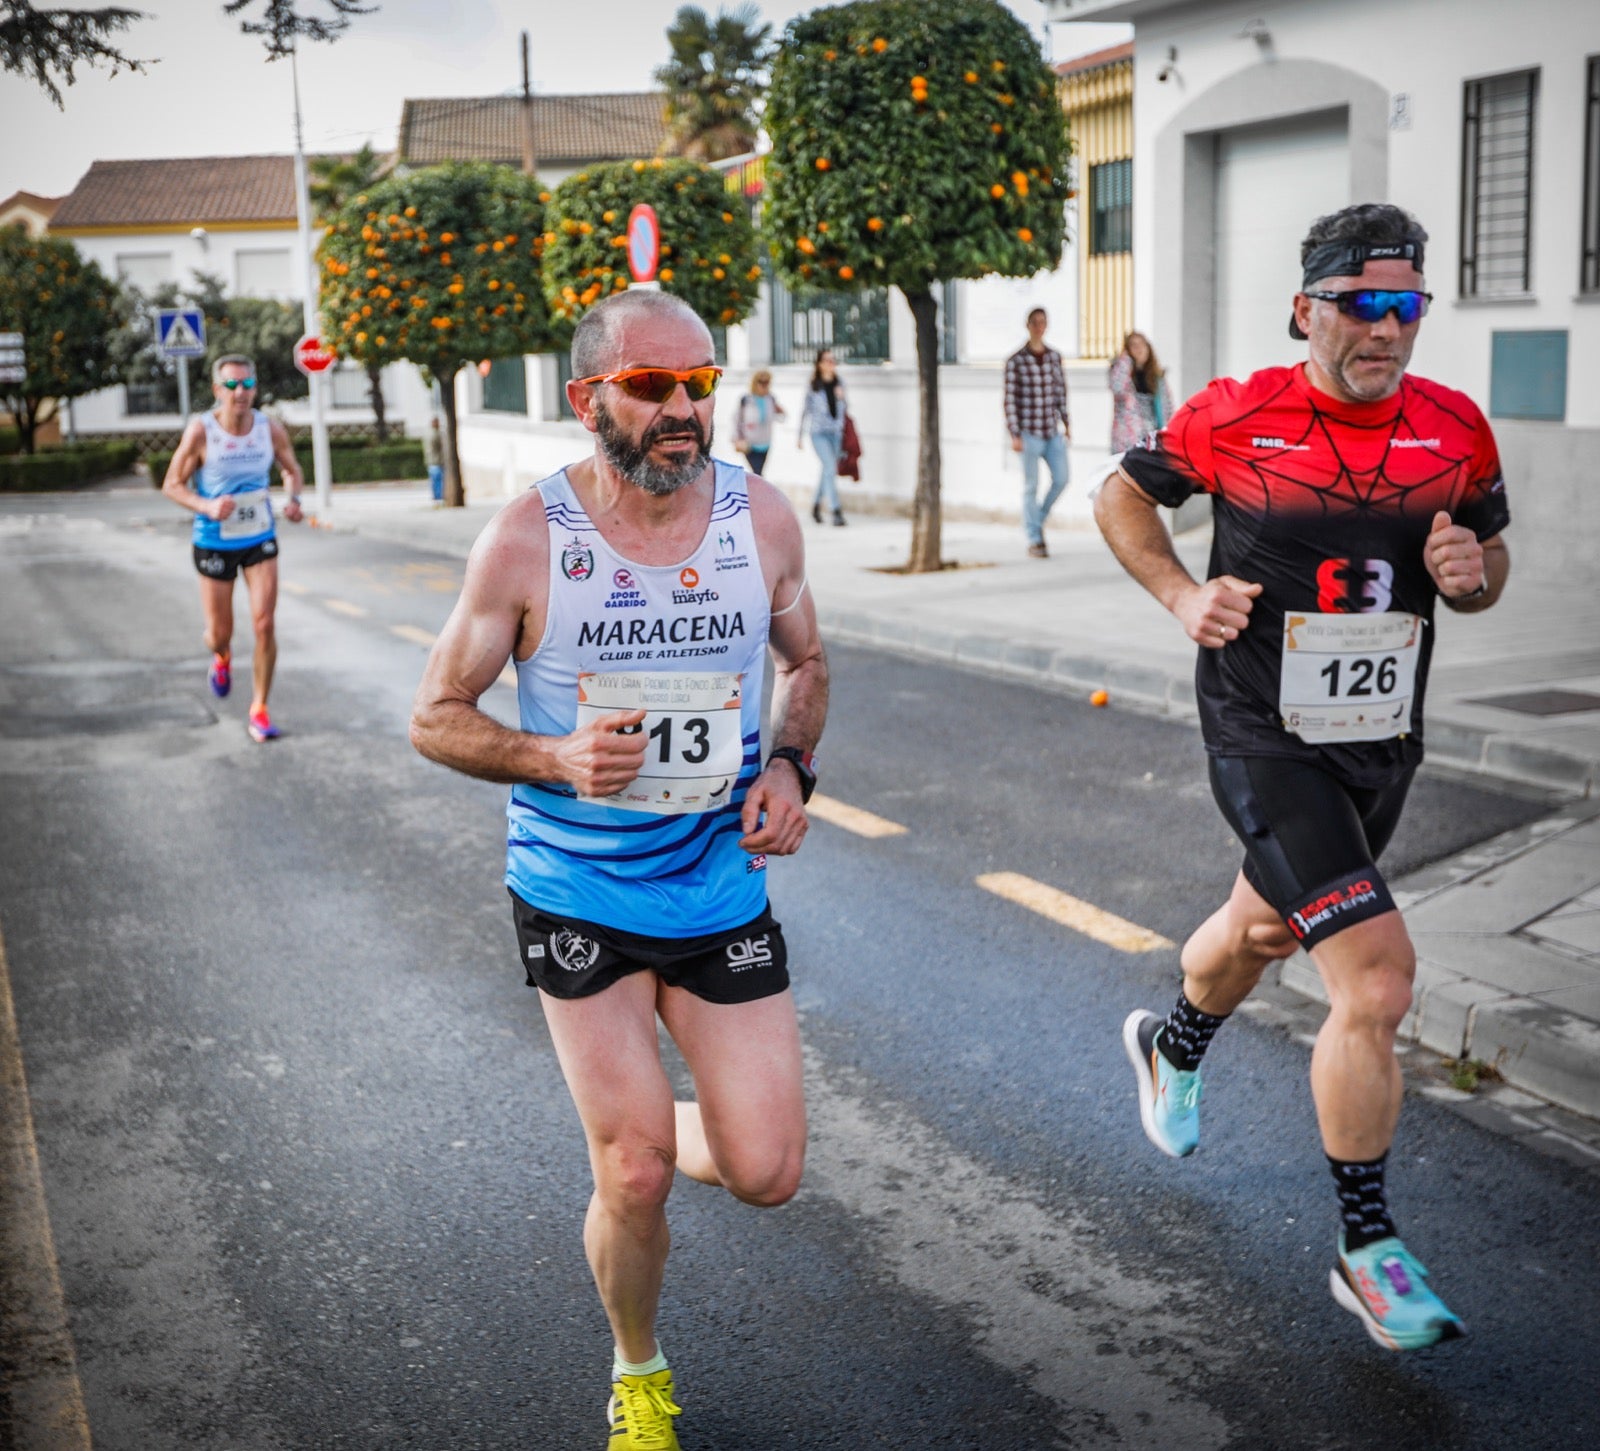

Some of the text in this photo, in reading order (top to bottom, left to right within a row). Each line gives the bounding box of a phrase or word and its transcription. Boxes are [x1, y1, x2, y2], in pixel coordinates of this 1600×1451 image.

[604, 599, 647, 608] GARRIDO
[610, 591, 640, 600] SPORT
[672, 589, 719, 605] mayfo
[577, 611, 746, 647] MARACENA
[599, 645, 729, 661] CLUB DE ATLETISMO
[1321, 656, 1397, 697] 126
